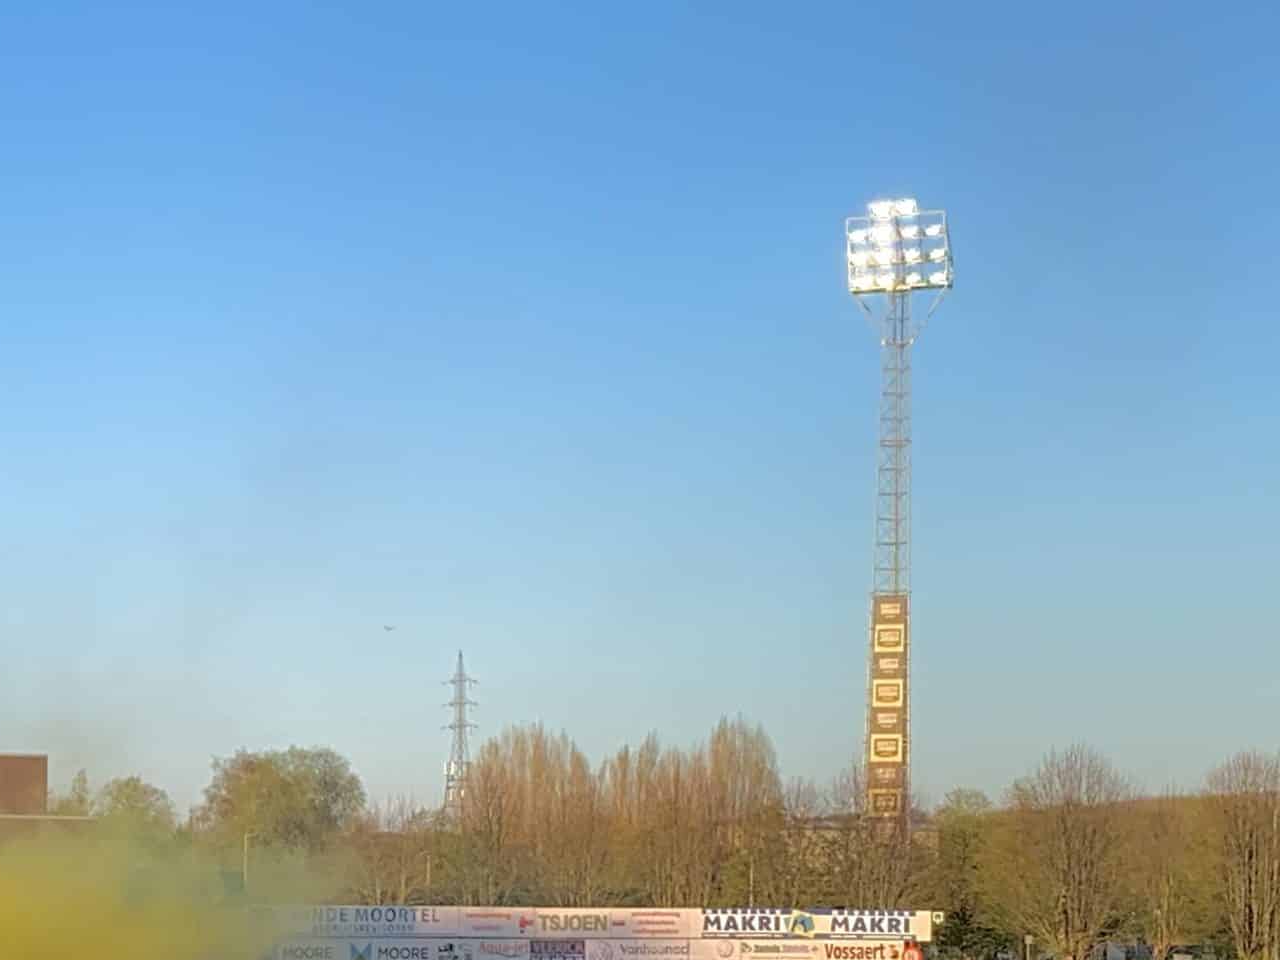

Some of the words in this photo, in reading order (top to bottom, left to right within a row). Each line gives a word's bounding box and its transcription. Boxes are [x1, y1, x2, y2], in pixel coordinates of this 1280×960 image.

[354, 907, 440, 923] MOORTEL
[538, 914, 608, 931] TSJOEN
[703, 914, 781, 932] MAKRI
[830, 917, 910, 934] MAKRI
[377, 947, 429, 960] MOORE
[824, 943, 886, 960] Vossaert
